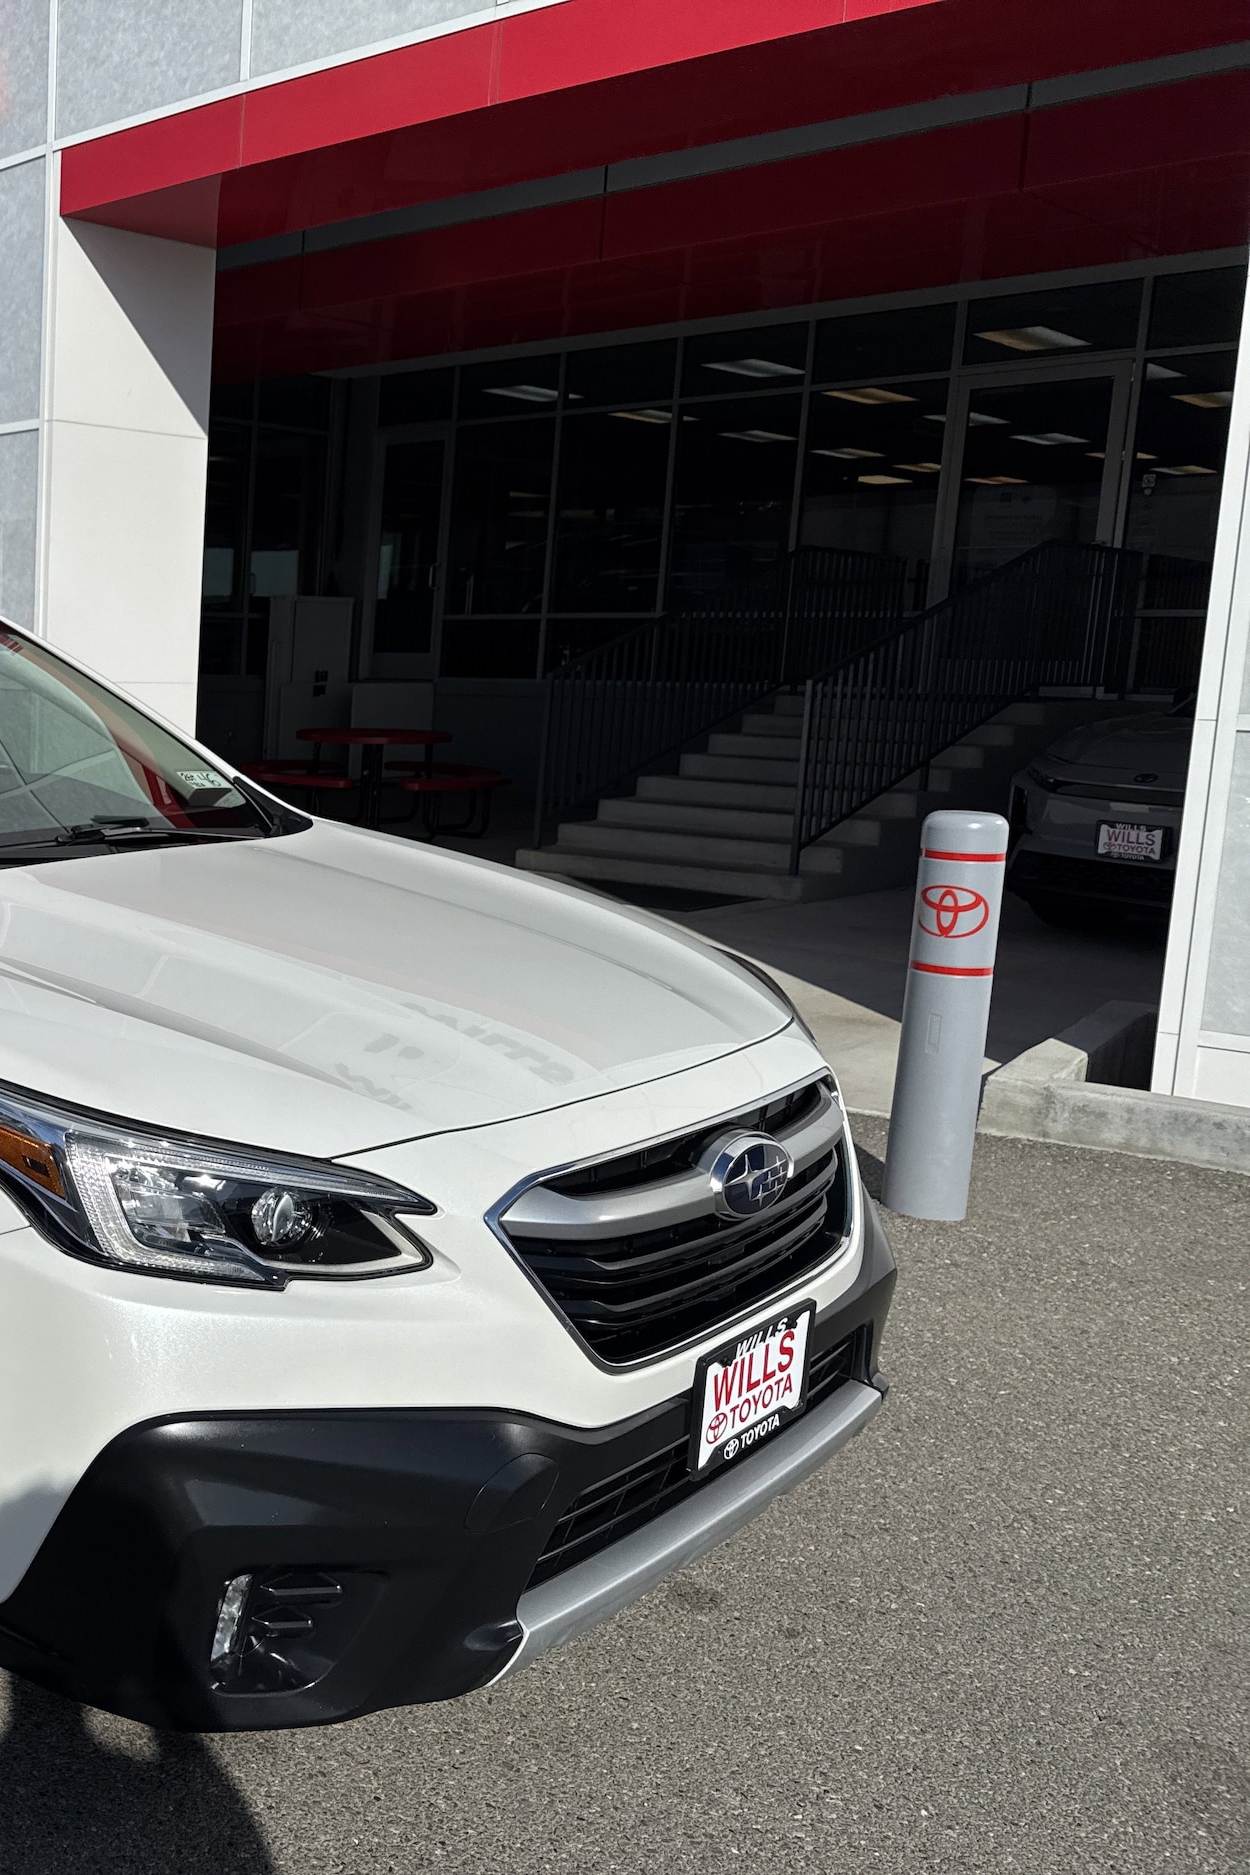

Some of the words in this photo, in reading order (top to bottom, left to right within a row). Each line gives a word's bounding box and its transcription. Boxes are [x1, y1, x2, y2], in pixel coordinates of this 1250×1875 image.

[1106, 829, 1155, 846] WILLS
[1116, 823, 1147, 832] WILLS
[1118, 843, 1156, 855] TOYOTA
[735, 1317, 789, 1357] WILLS
[713, 1330, 795, 1412] WILLS
[729, 1373, 793, 1429] TOYOTA
[740, 1413, 780, 1449] TOYOTA
